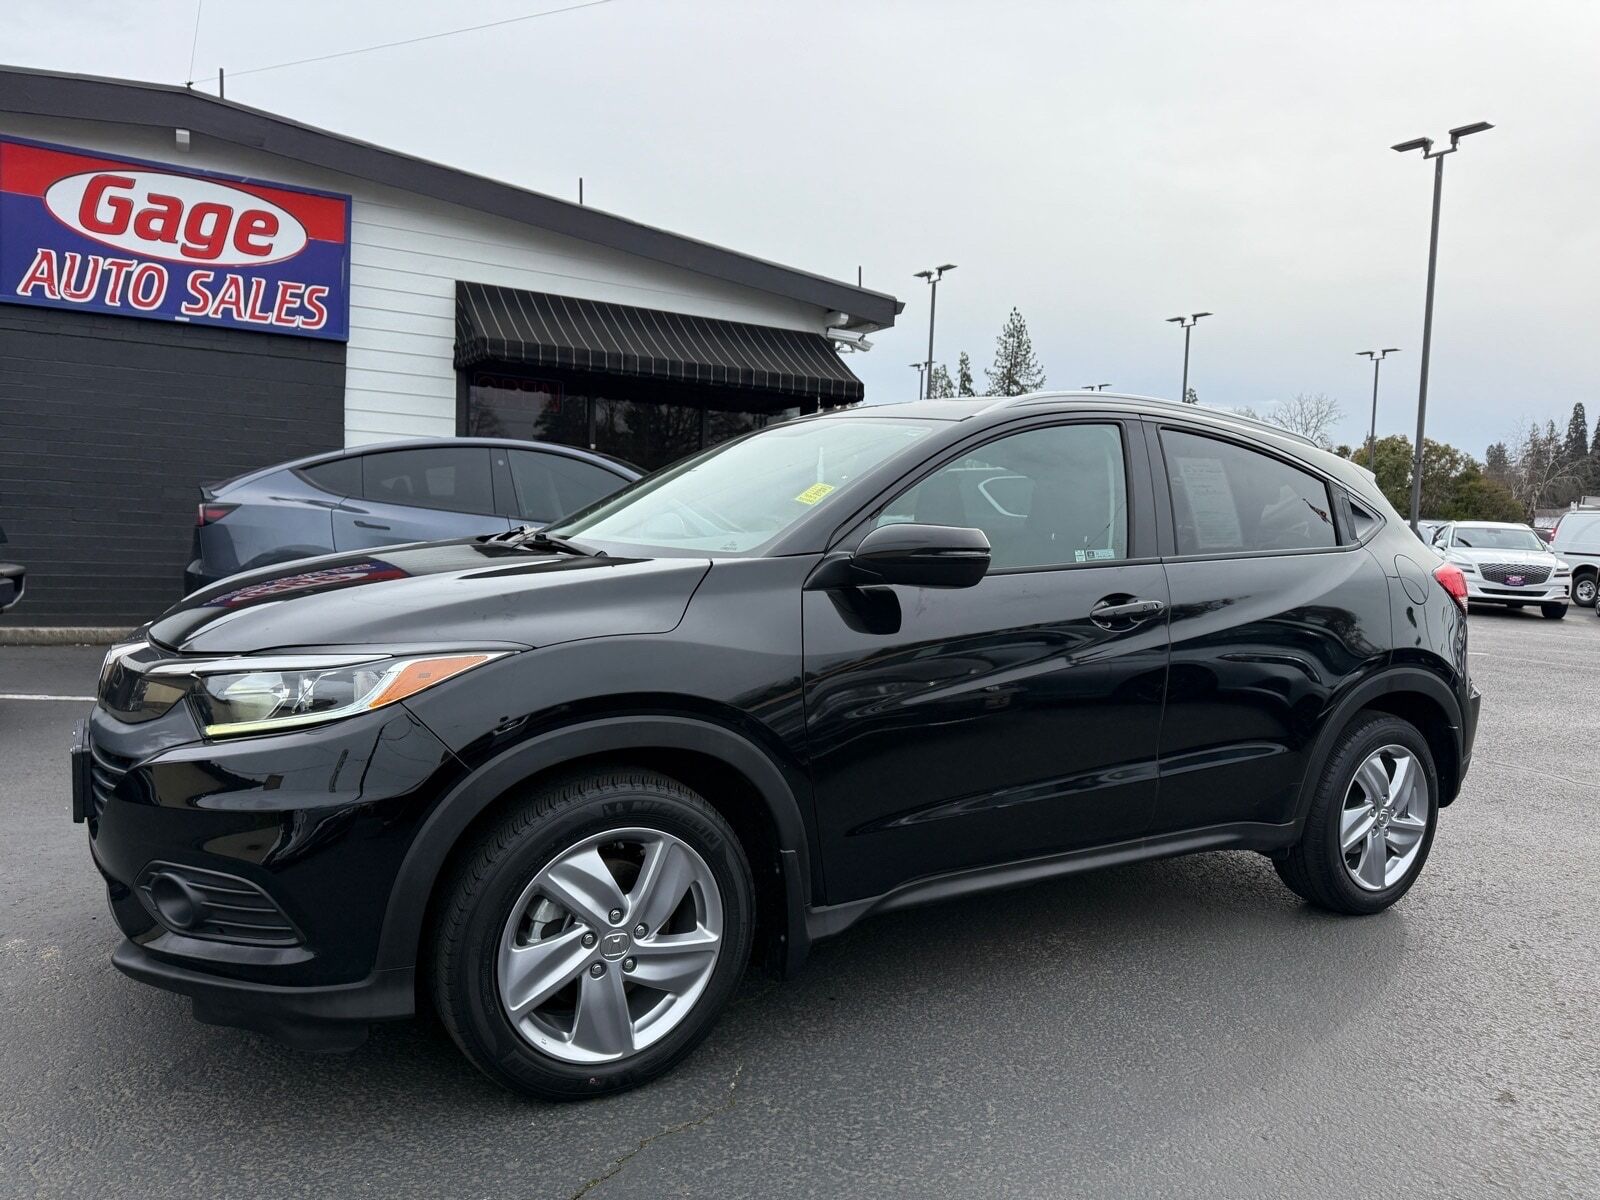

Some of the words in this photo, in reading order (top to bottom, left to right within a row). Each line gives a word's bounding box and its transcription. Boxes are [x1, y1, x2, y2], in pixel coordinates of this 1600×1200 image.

[79, 174, 279, 260] Gage
[16, 248, 169, 310] AUTO
[181, 269, 329, 330] SALES
[631, 799, 722, 852] MICHELIN
